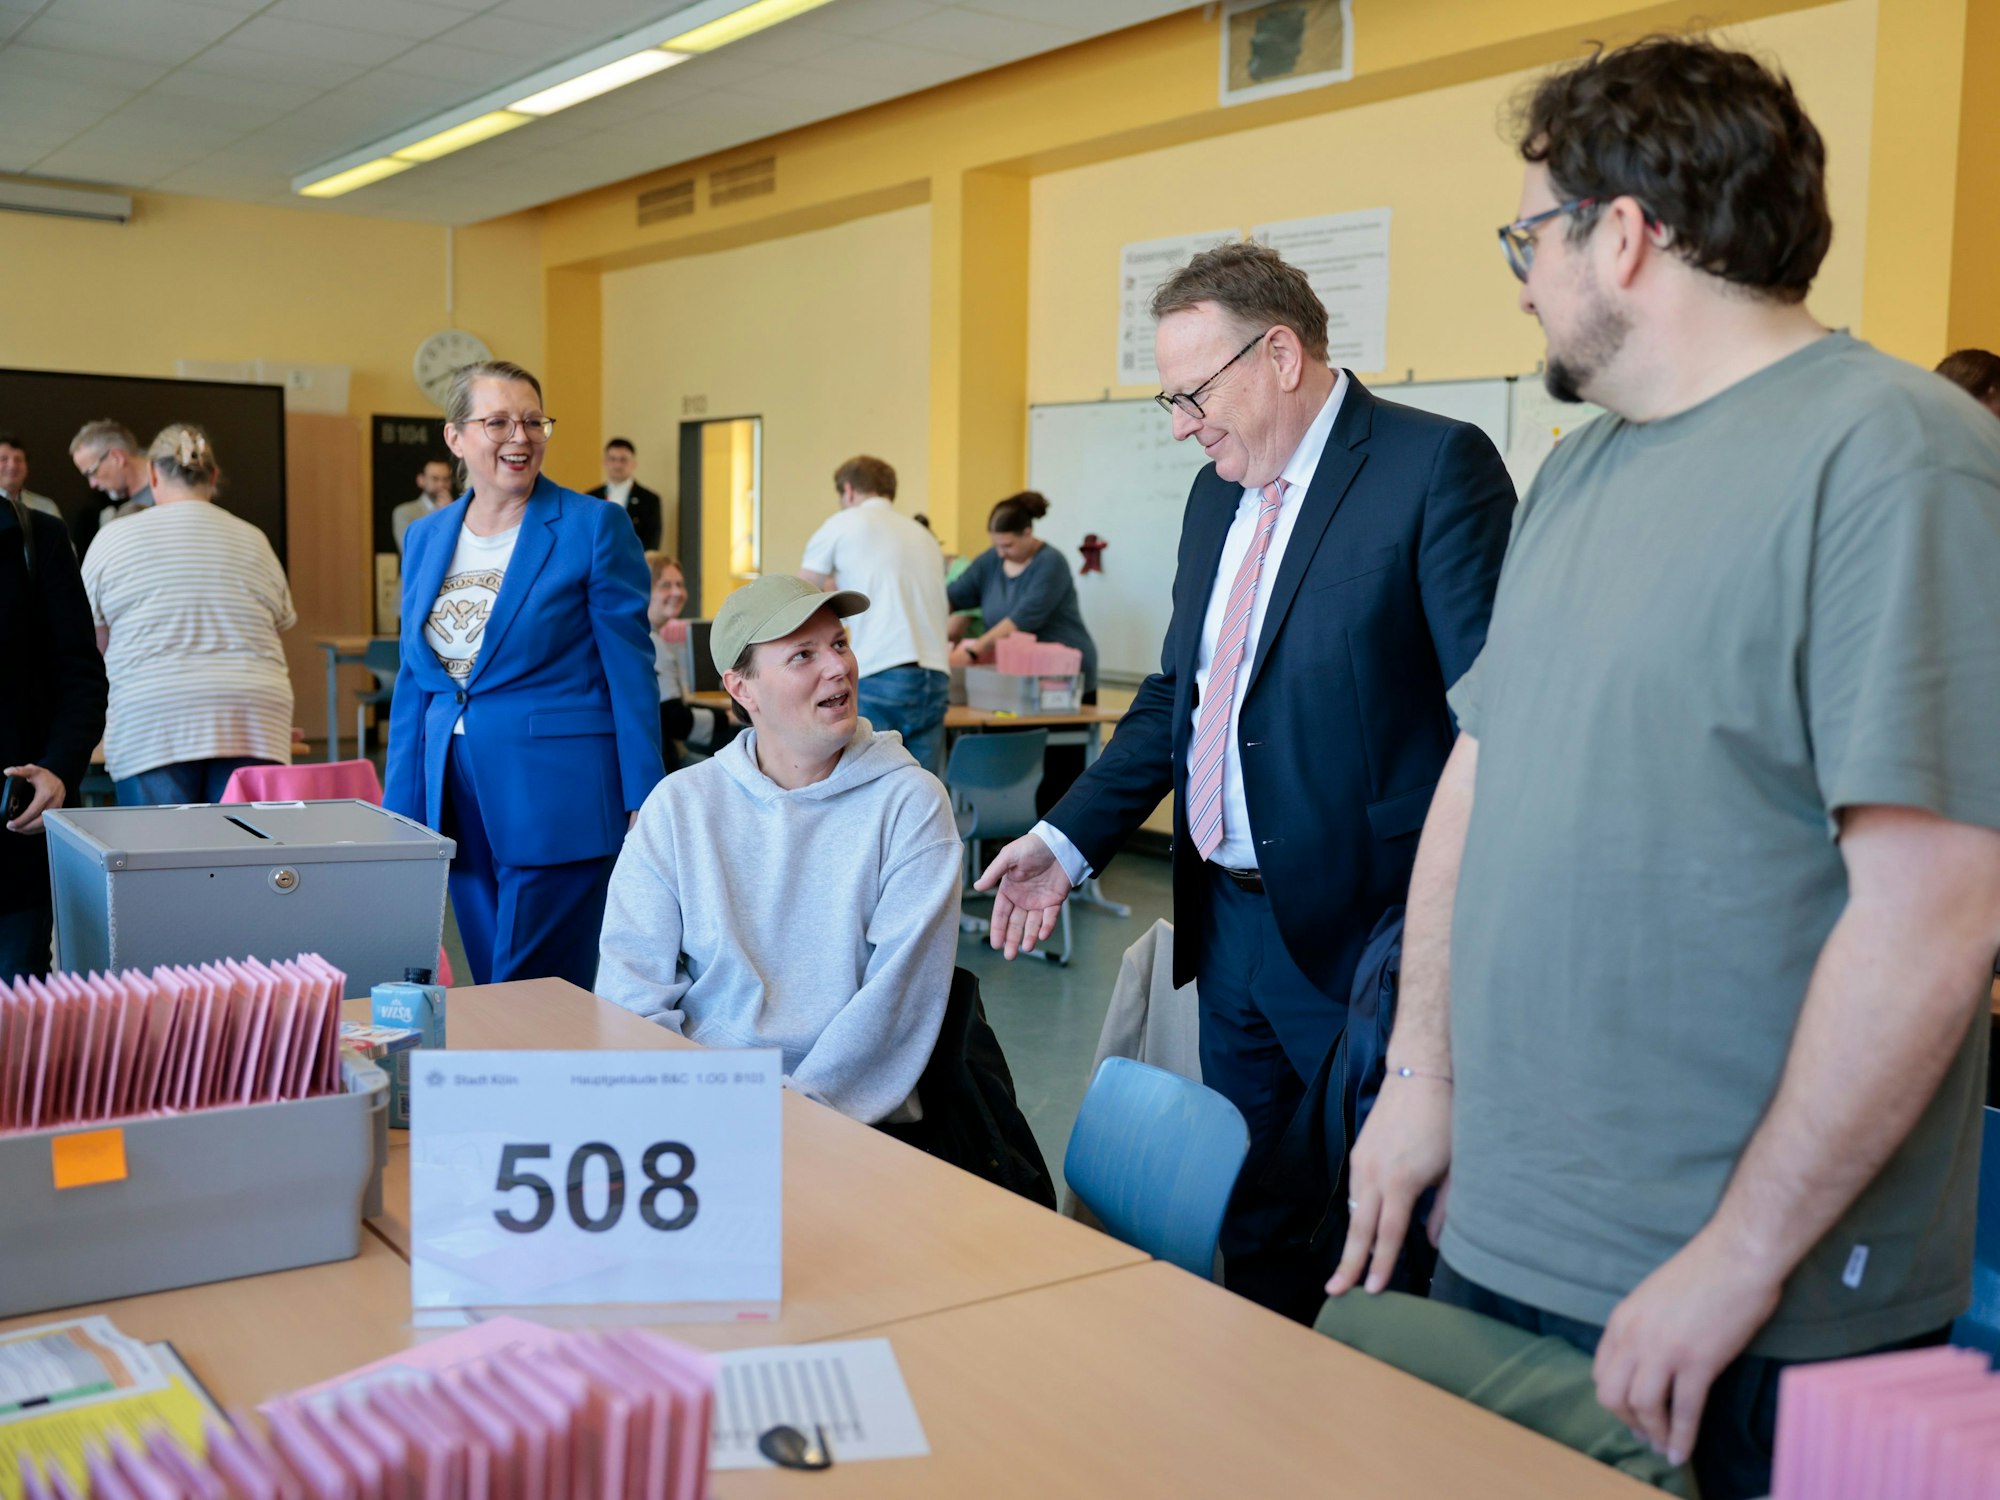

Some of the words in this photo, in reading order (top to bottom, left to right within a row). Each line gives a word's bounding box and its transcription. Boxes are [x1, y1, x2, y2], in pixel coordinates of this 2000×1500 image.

[381, 1005, 413, 1022] VILSA
[453, 1073, 488, 1086] Stadt
[490, 1073, 518, 1086] Köln
[493, 1140, 699, 1234] 508
